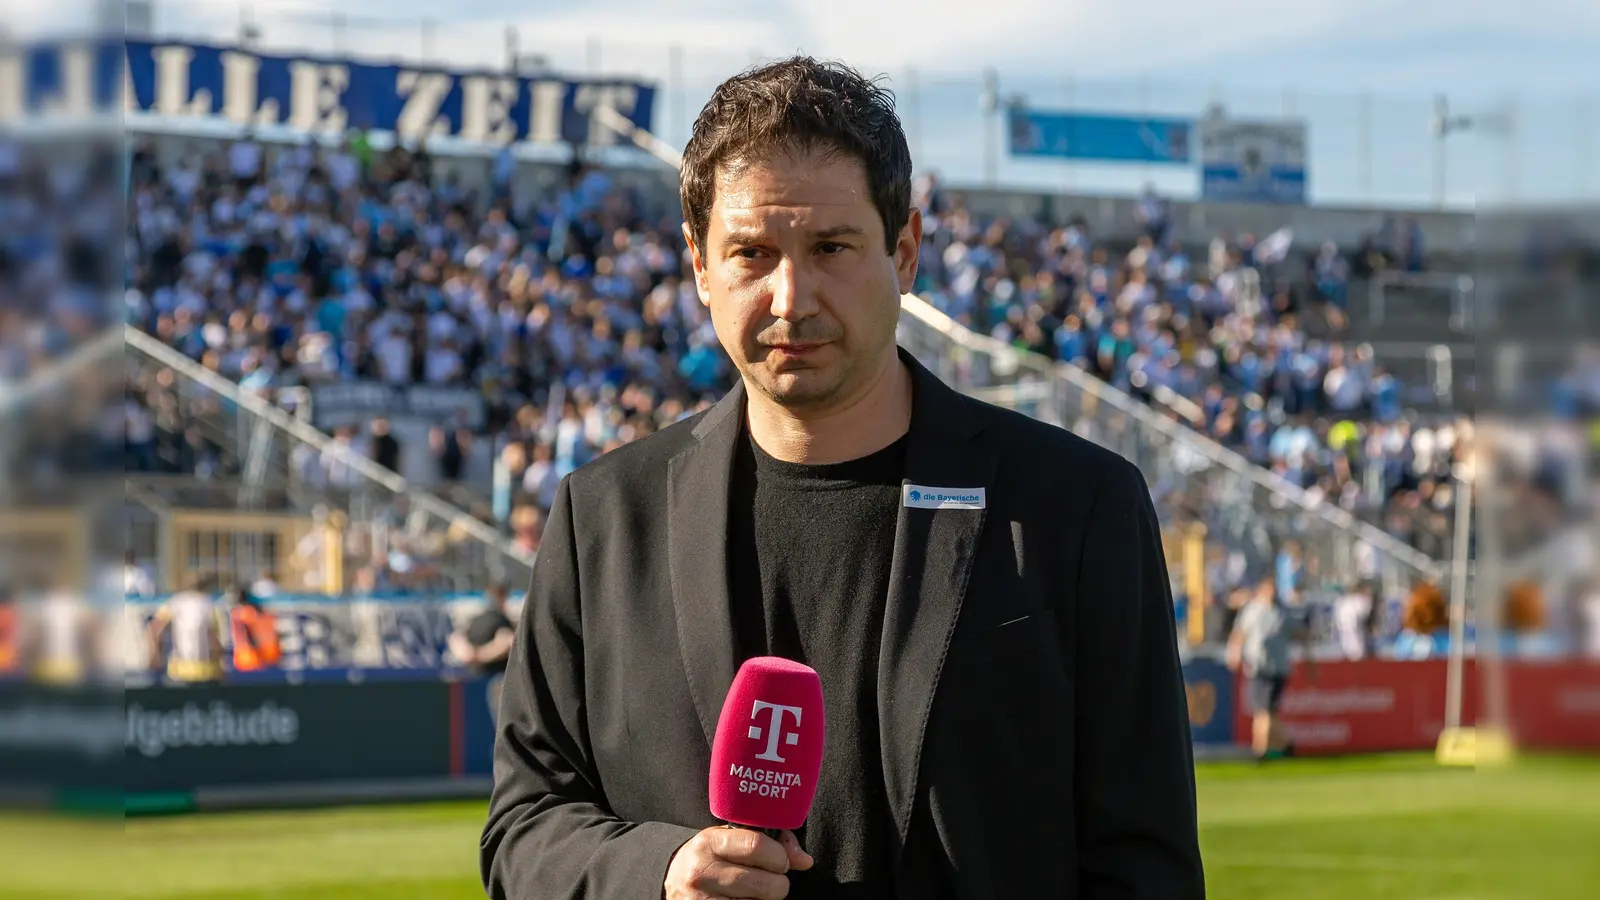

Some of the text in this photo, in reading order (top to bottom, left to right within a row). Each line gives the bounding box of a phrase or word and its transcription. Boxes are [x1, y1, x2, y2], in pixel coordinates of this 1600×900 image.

[125, 45, 349, 131] LLE
[396, 69, 638, 149] ZEIT
[923, 493, 979, 502] die Bayerische
[729, 763, 802, 787] MAGENTA
[738, 779, 790, 799] SPORT
